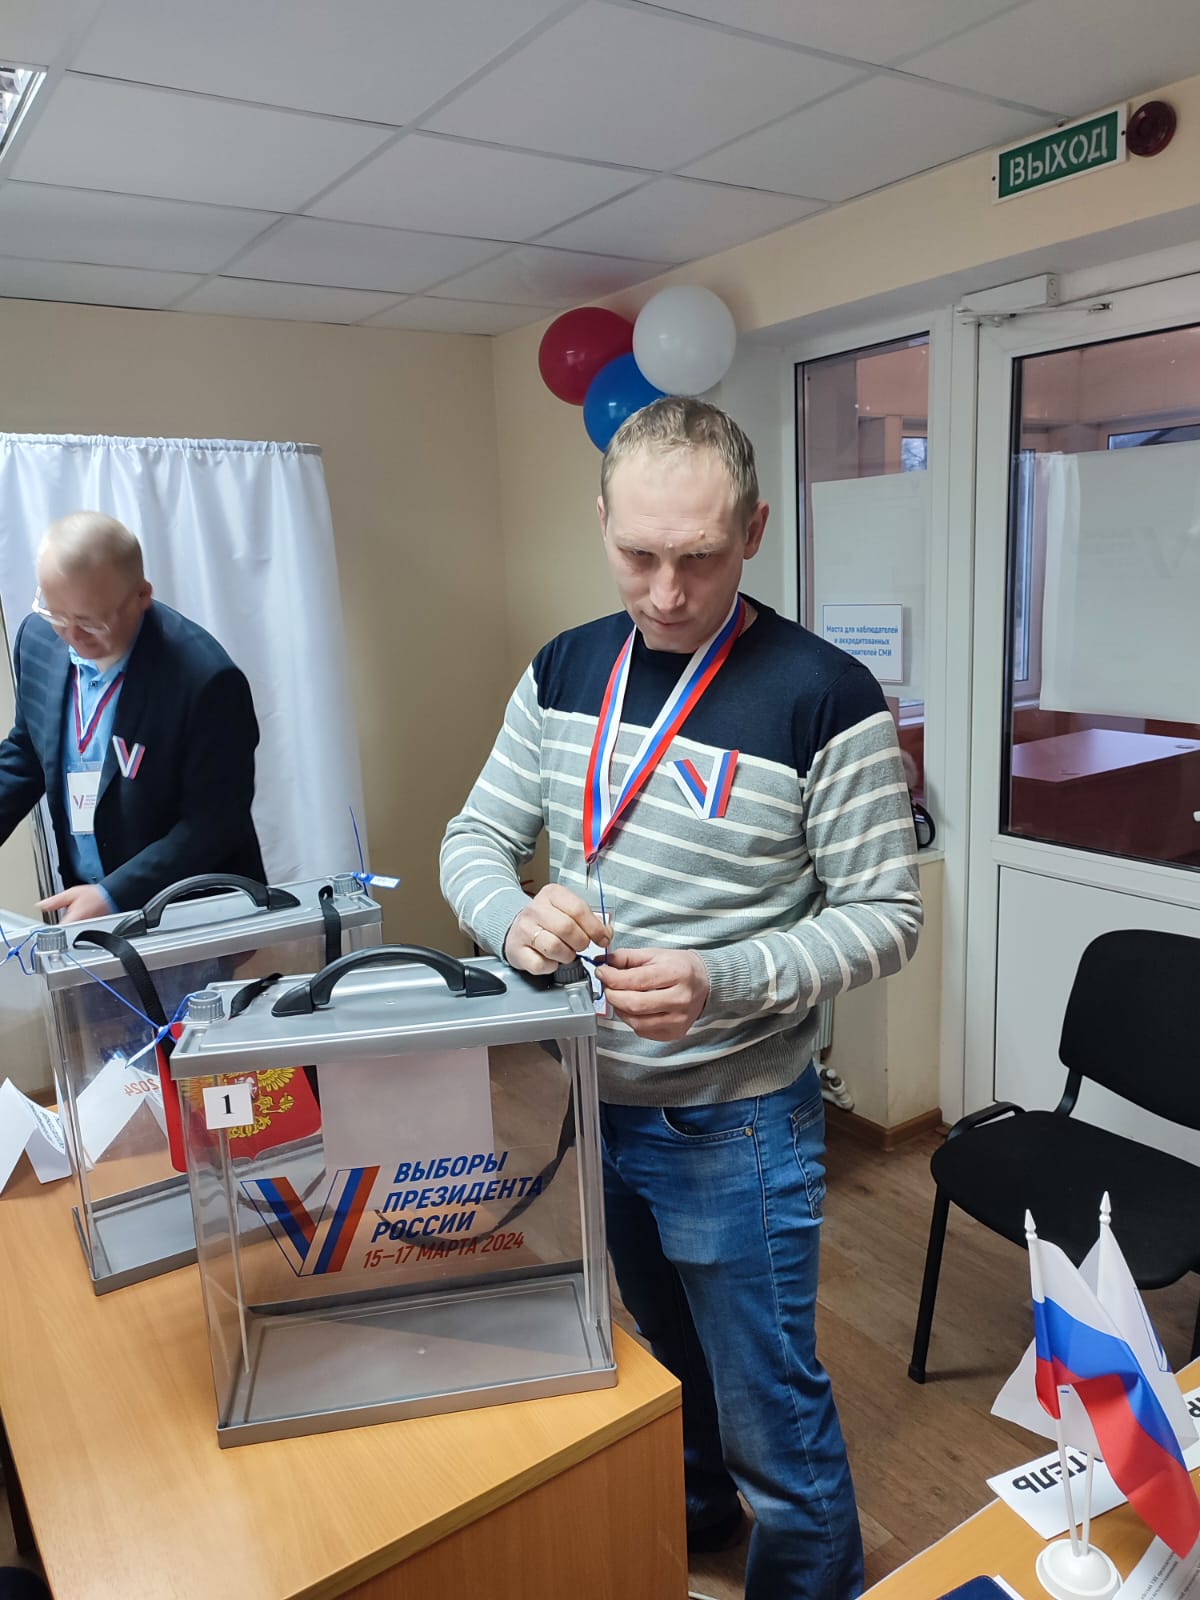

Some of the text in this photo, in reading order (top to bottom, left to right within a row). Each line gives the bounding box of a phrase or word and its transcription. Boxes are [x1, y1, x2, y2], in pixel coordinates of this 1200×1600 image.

[1009, 126, 1107, 187] ВЫХОД
[878, 648, 892, 656] СМИ
[221, 1093, 236, 1115] 1
[393, 1151, 509, 1184] ВЫБОРЫ
[382, 1175, 544, 1214] ПРЕЗИДЕНТА
[371, 1210, 477, 1243] РОССИИ
[415, 1236, 481, 1263] МАРТА
[480, 1231, 525, 1255] 2024
